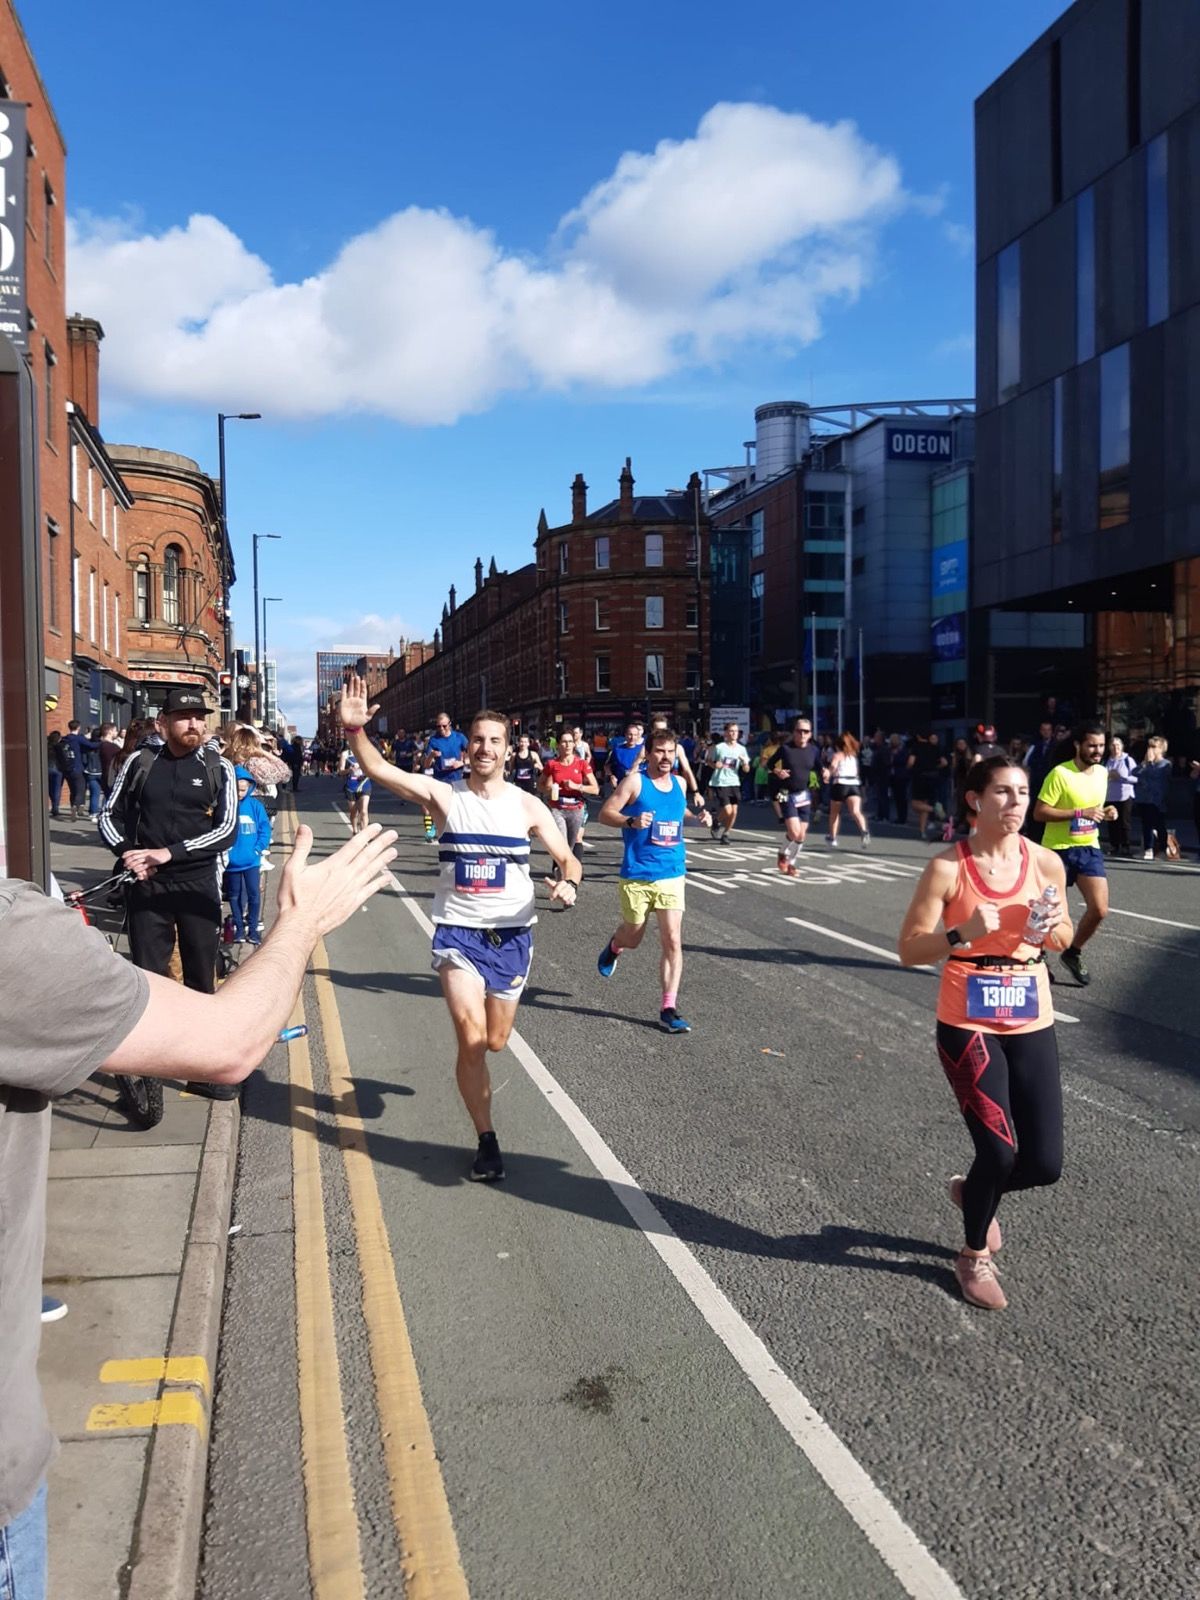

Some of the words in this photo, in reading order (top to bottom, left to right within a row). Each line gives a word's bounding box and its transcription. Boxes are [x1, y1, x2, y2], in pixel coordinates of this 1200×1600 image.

[892, 433, 950, 455] ODEON
[464, 864, 496, 880] 11908
[982, 986, 1026, 1007] 13108
[995, 1007, 1013, 1017] KATE
